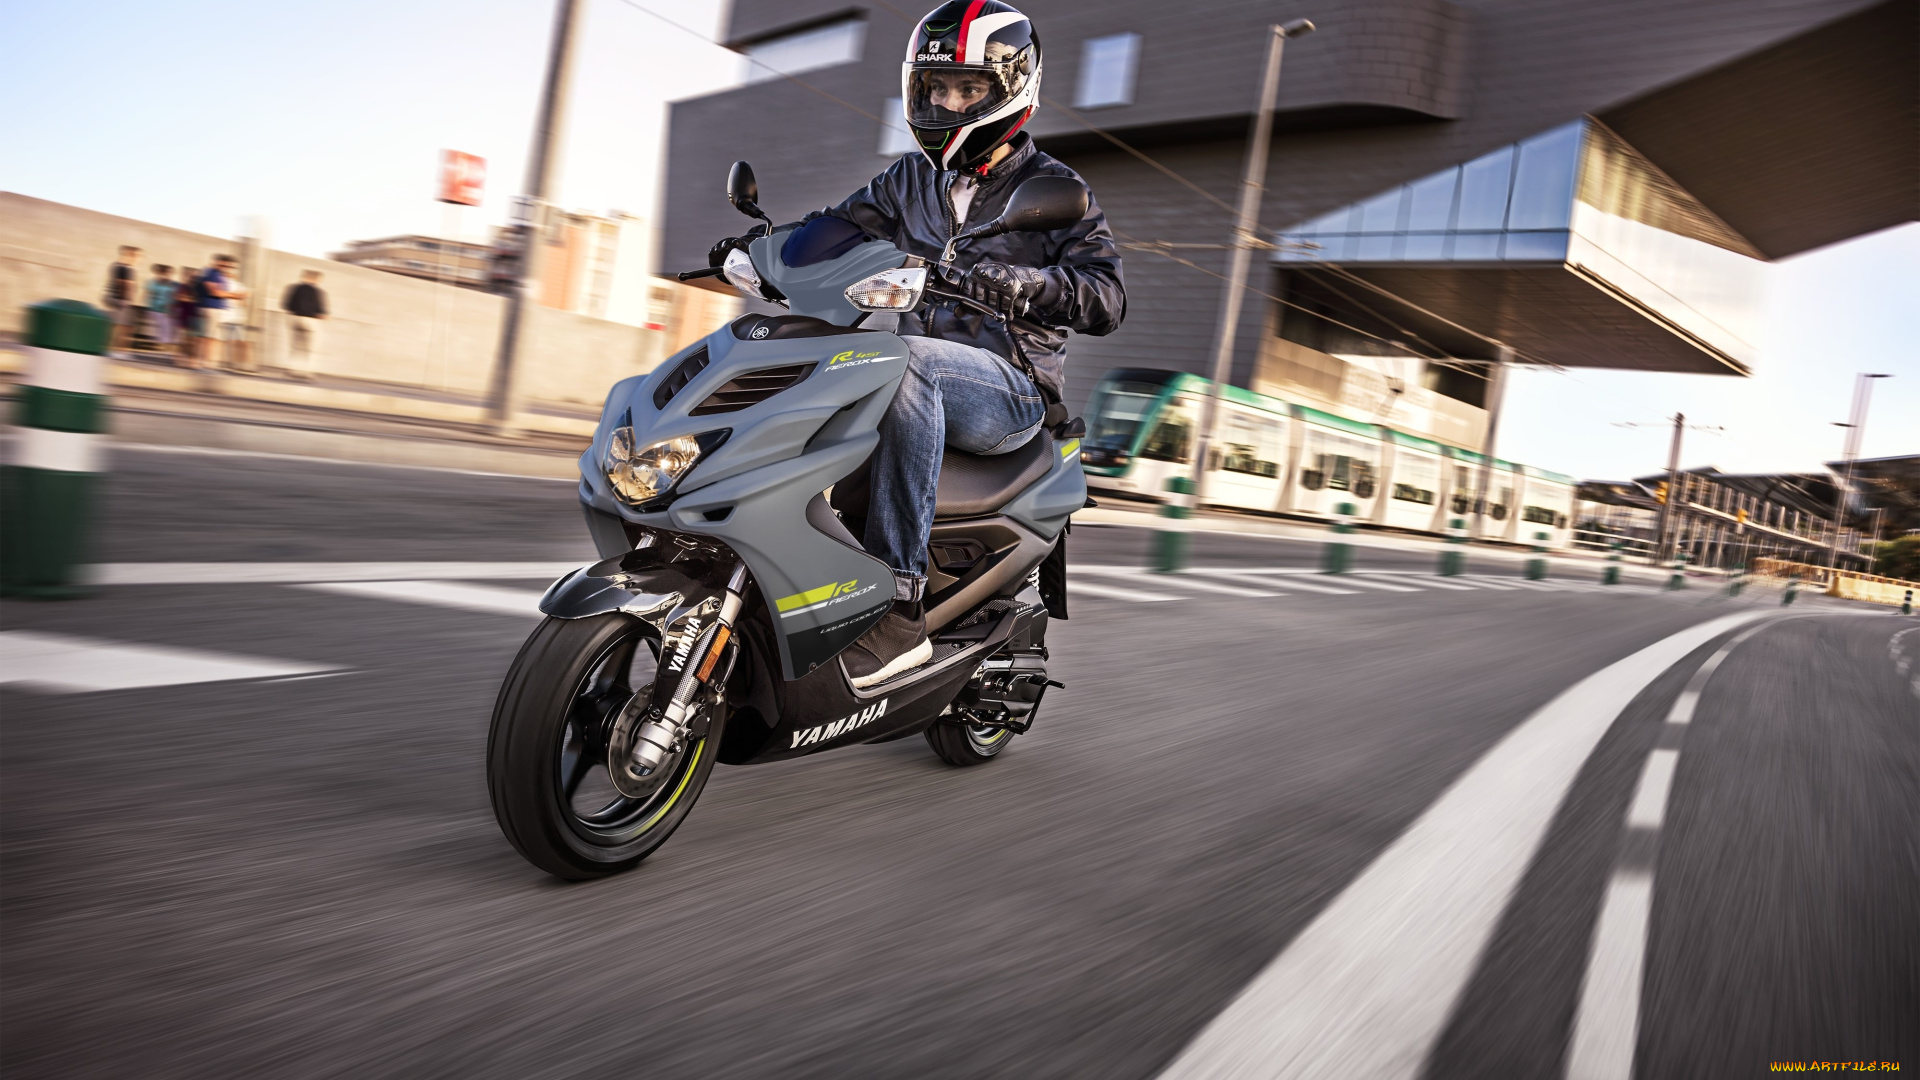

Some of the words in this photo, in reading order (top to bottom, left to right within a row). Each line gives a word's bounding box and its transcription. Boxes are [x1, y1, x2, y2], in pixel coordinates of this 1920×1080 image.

[916, 53, 953, 62] SHARK
[824, 358, 871, 372] AEROX
[830, 350, 854, 365] R
[829, 583, 877, 606] AEROX
[833, 579, 858, 597] R
[668, 617, 702, 673] YAMAHA
[789, 697, 889, 749] YAMAHA
